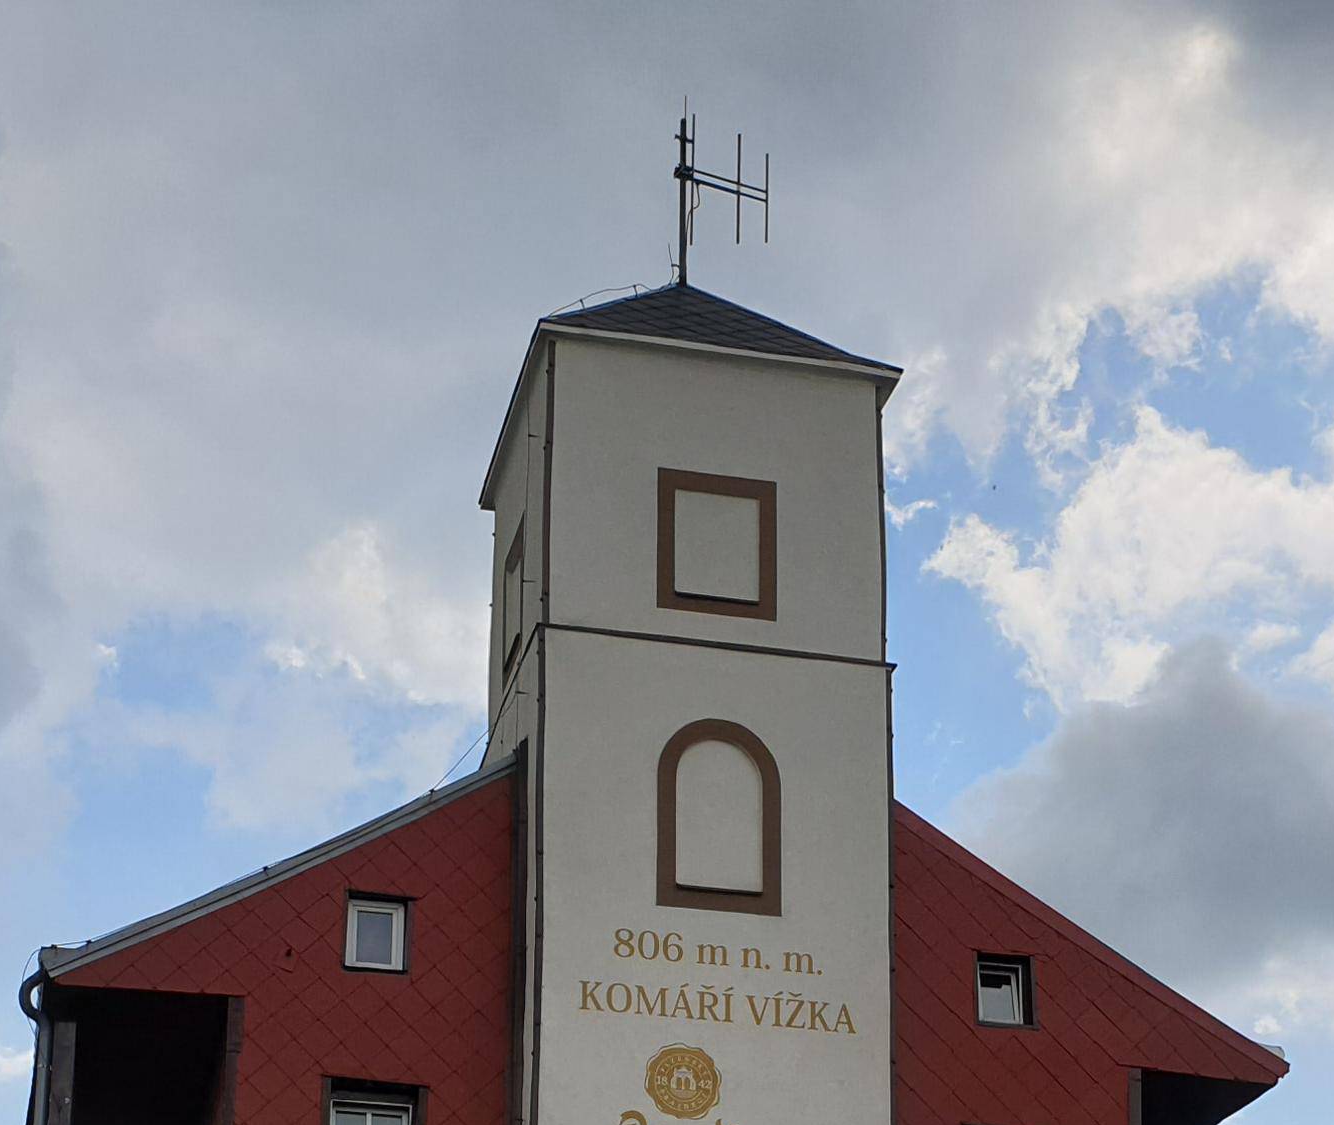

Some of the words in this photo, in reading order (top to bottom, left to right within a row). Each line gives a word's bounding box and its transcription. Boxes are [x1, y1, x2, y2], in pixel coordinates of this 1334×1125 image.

[614, 929, 684, 961] 806
[697, 944, 729, 966] m
[741, 948, 770, 970] n.
[783, 951, 822, 976] m.
[579, 981, 734, 1023] KOMÁŘÍ
[745, 992, 857, 1034] VÍŽKA
